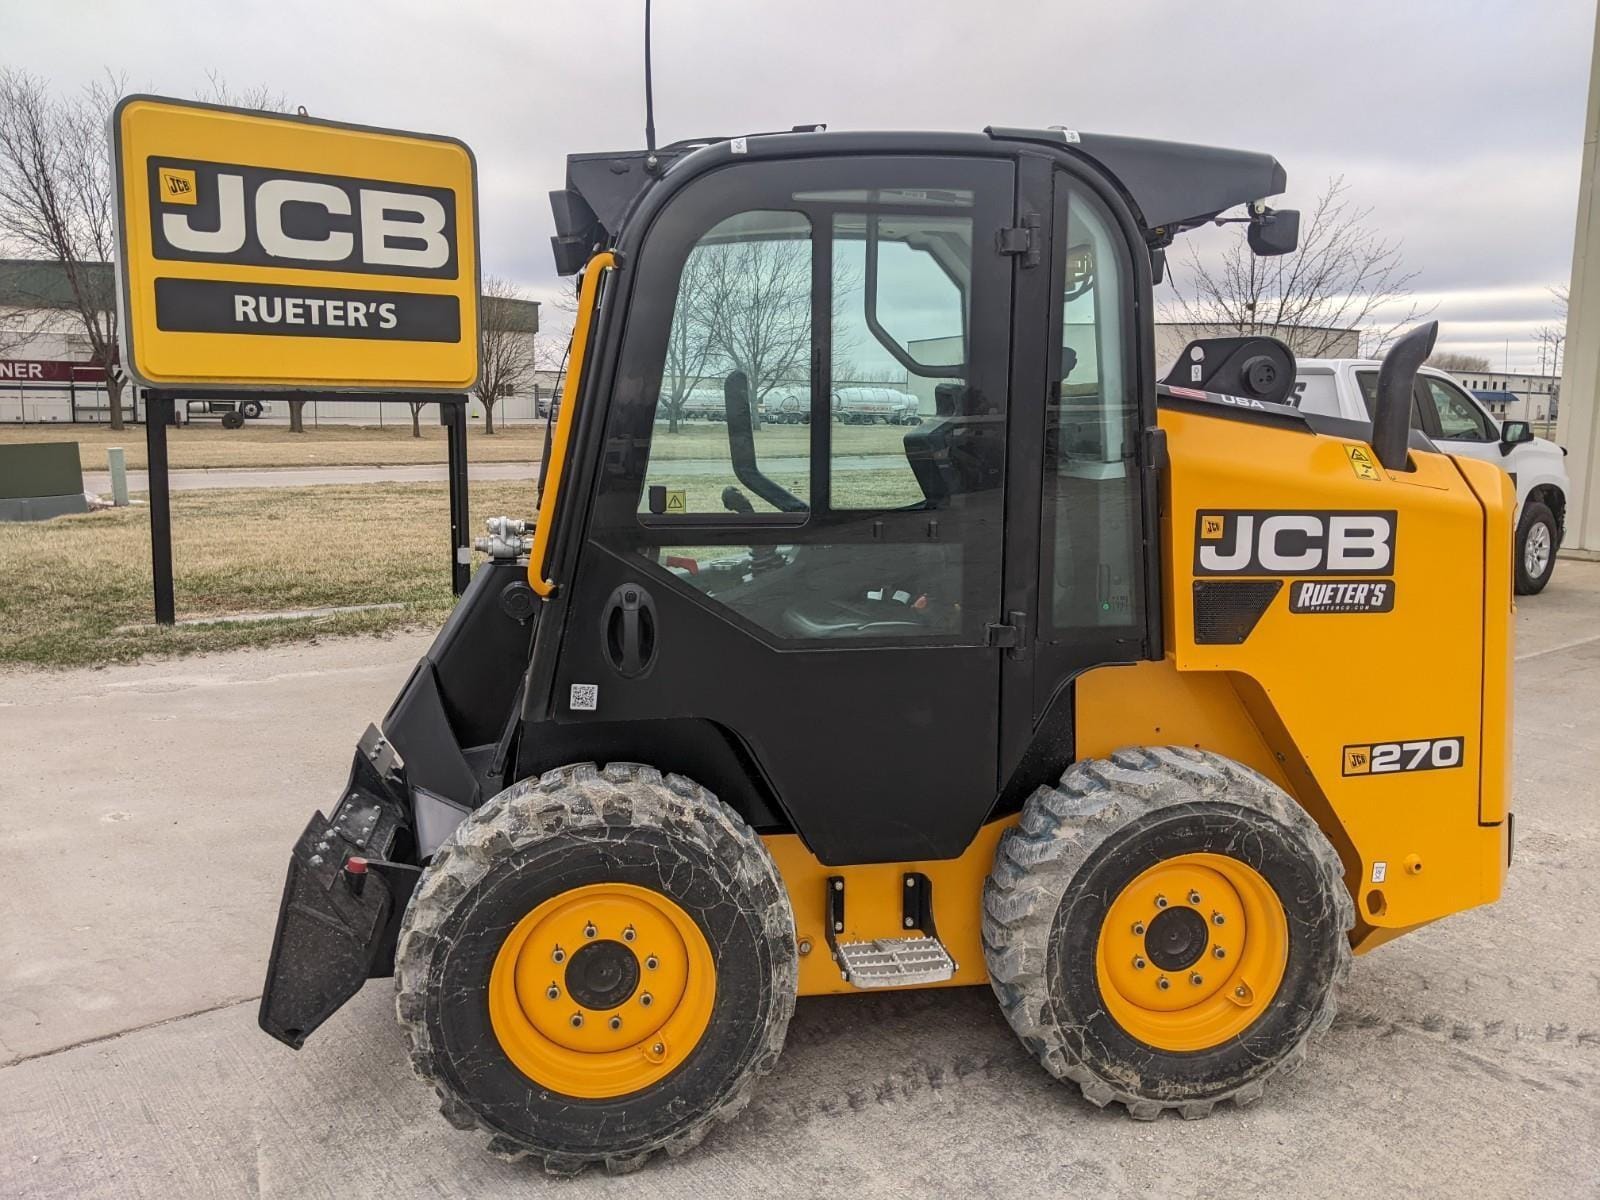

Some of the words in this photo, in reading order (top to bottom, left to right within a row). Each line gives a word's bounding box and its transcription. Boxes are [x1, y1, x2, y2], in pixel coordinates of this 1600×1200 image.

[169, 177, 191, 193] JCB
[162, 173, 449, 268] JCB
[234, 294, 397, 329] RUETER'S
[1220, 394, 1265, 409] USA
[1200, 516, 1390, 570] JCB
[1297, 582, 1387, 608] RUETER'S
[1371, 739, 1460, 773] 270
